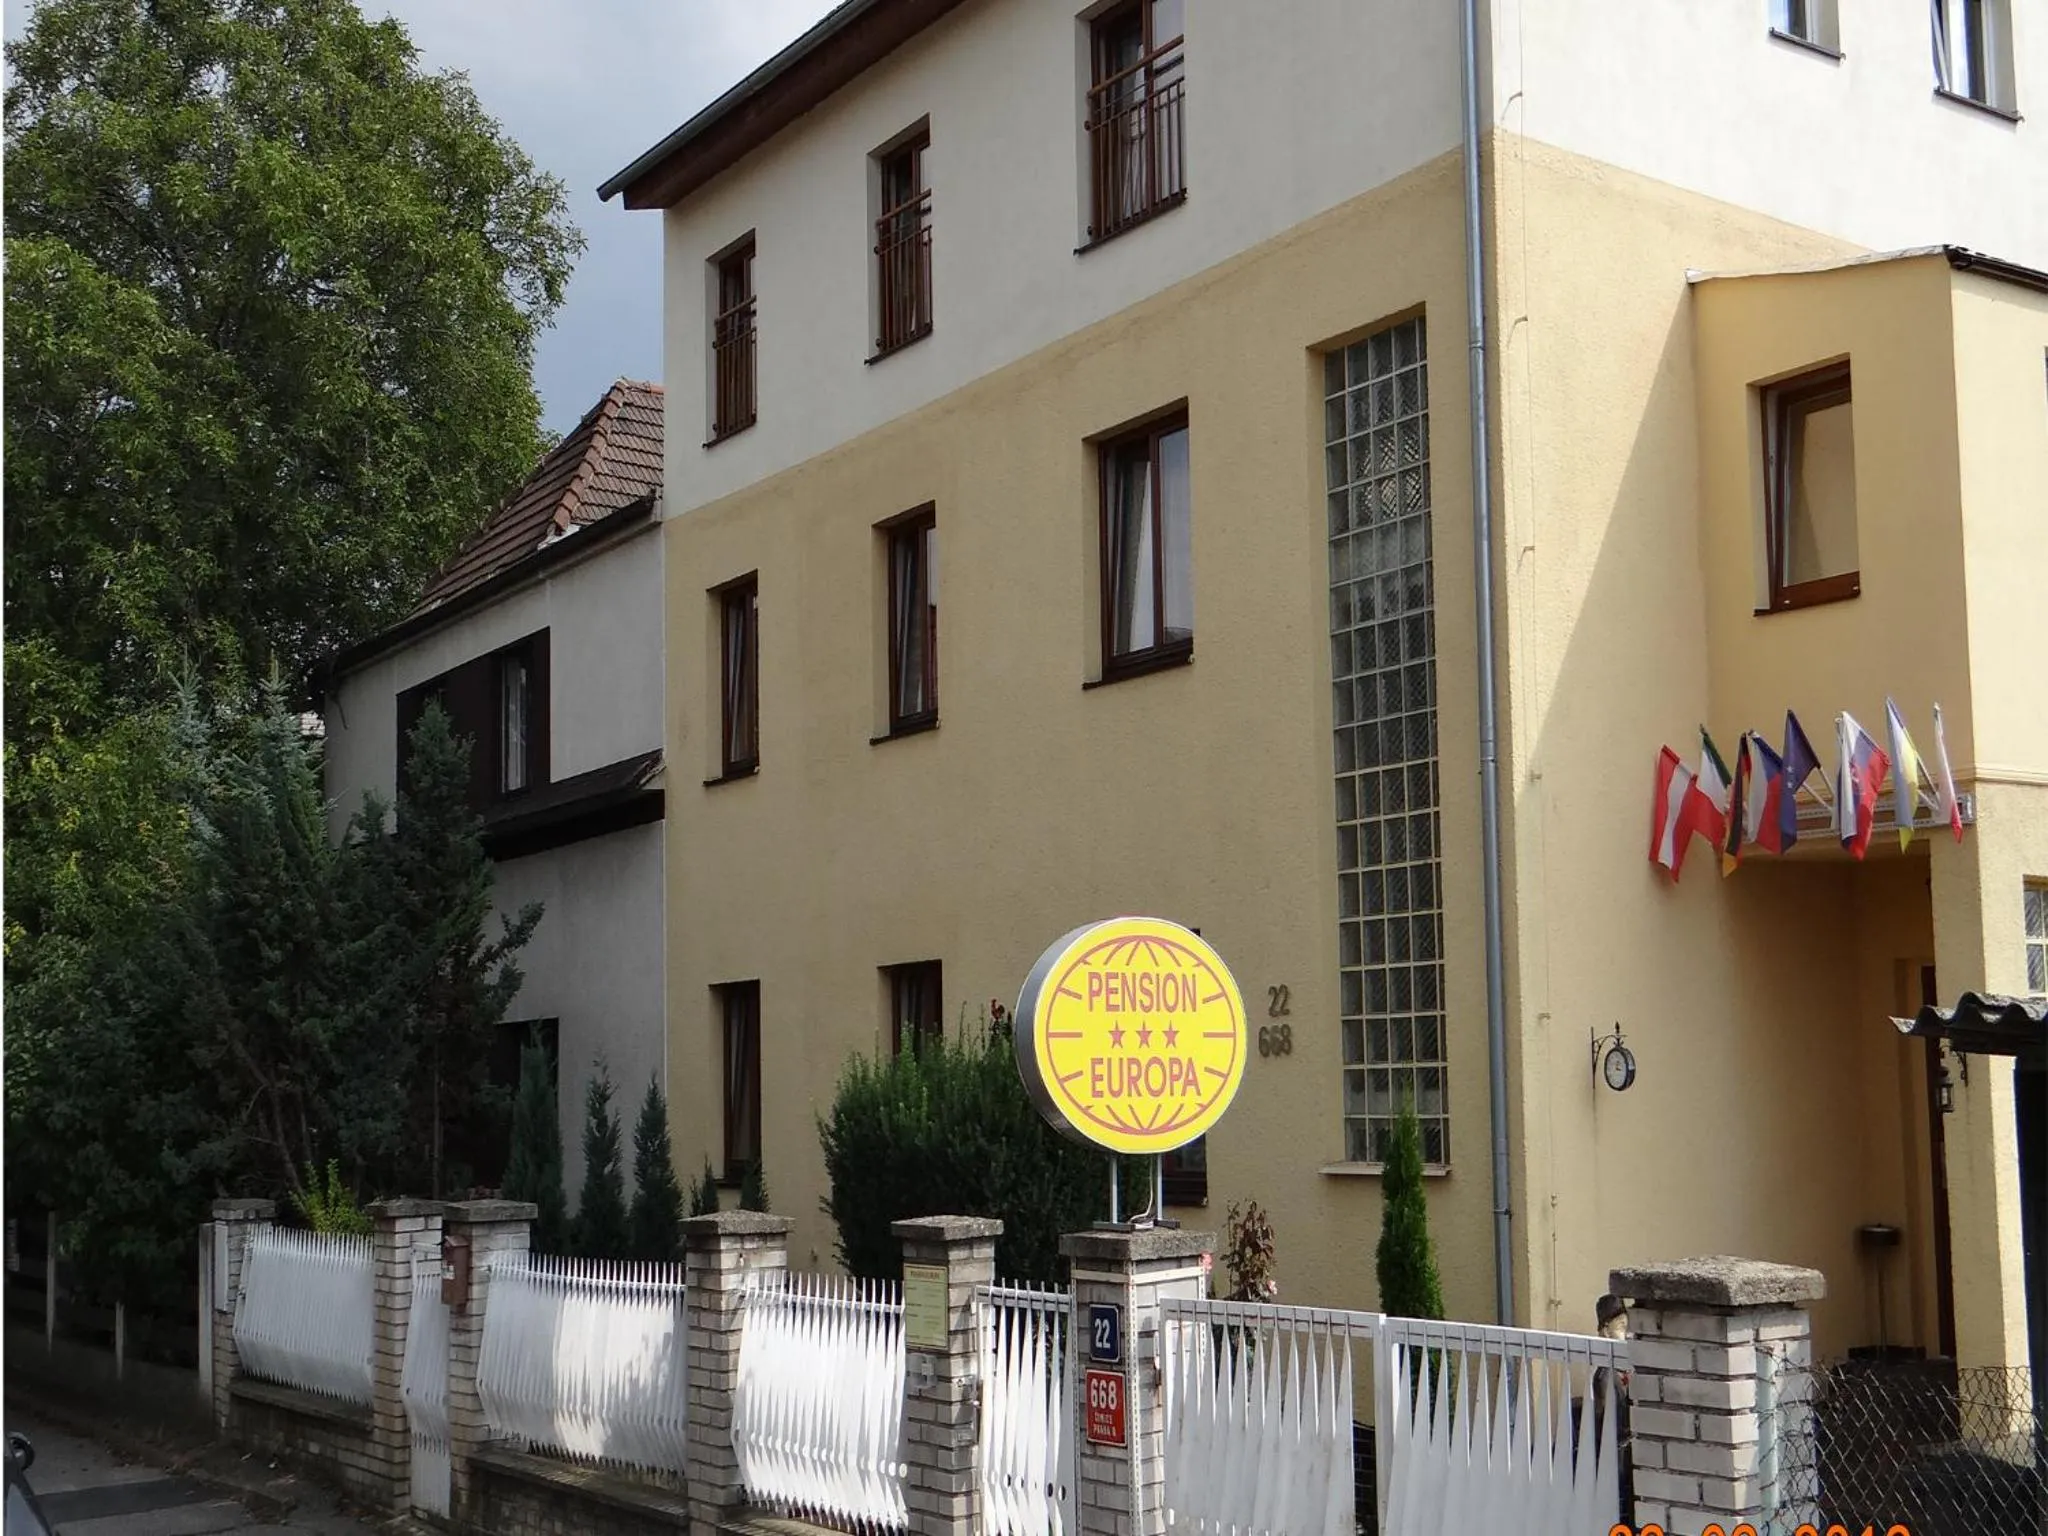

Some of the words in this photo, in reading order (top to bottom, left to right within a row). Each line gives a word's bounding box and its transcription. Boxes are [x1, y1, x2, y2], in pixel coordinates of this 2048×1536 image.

[1088, 972, 1197, 1013] PENSION
[1268, 984, 1290, 1017] 22
[1259, 1024, 1292, 1058] 668
[1090, 1057, 1201, 1098] EUROPA
[1094, 1318, 1111, 1349] 22
[1090, 1378, 1117, 1410] 668
